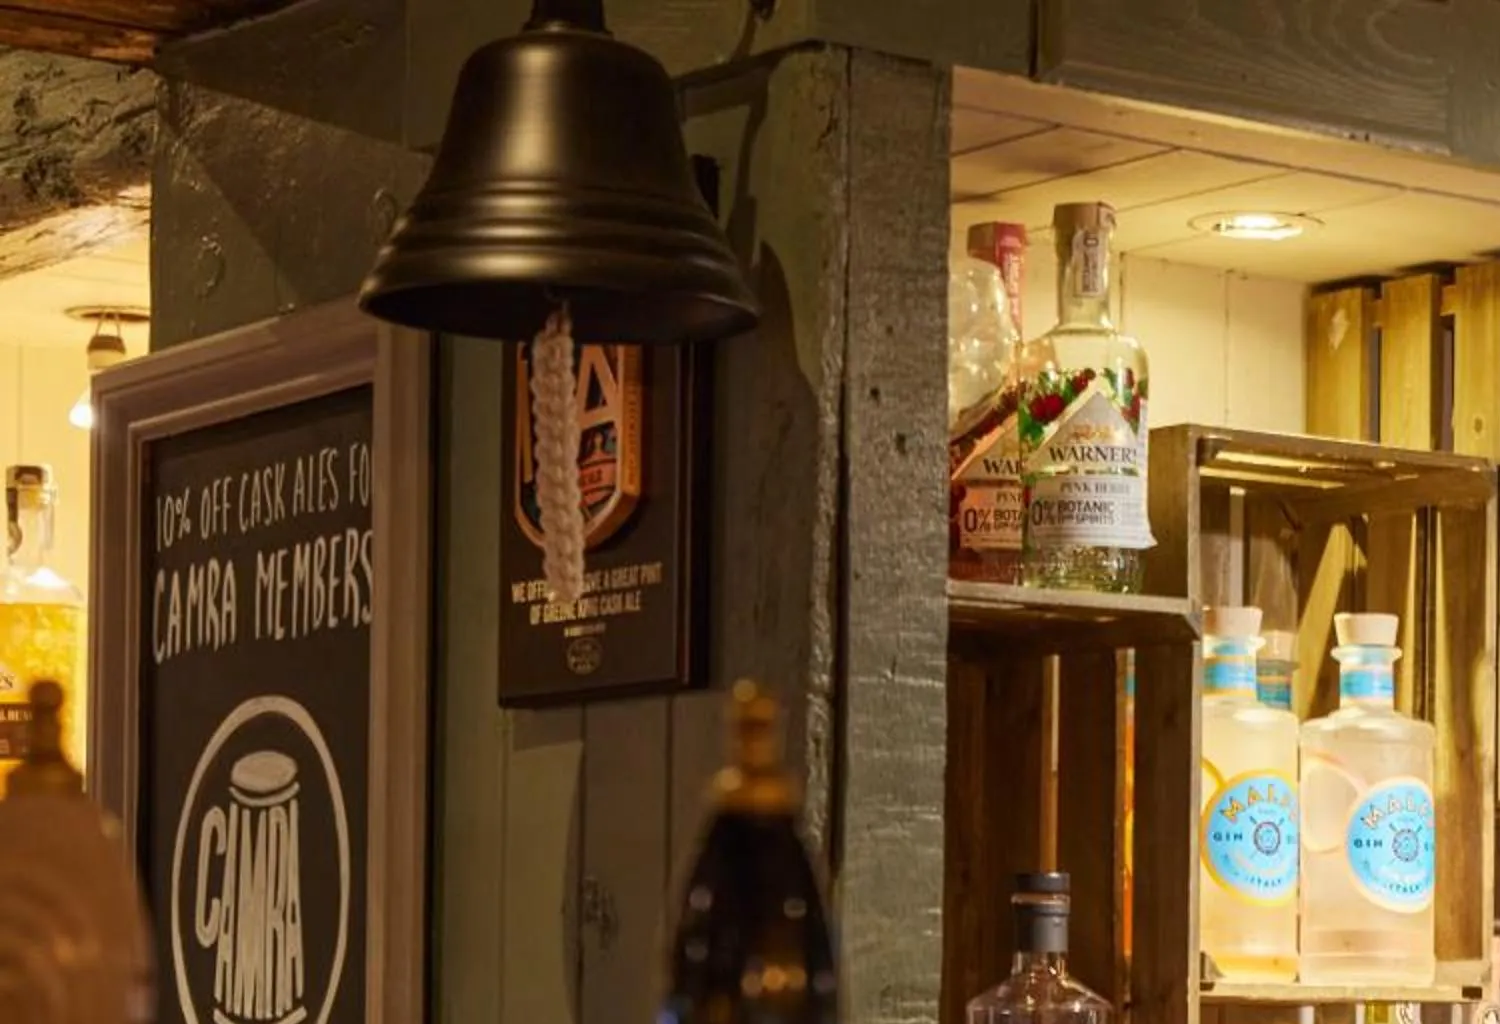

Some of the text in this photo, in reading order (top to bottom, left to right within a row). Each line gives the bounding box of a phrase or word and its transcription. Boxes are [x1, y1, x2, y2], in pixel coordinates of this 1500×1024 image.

[156, 441, 373, 551] 10% OFF CASK ALES FO
[153, 527, 373, 665] CAMRA MEMBERS
[1213, 832, 1243, 842] GIN
[1353, 838, 1383, 849] GIN
